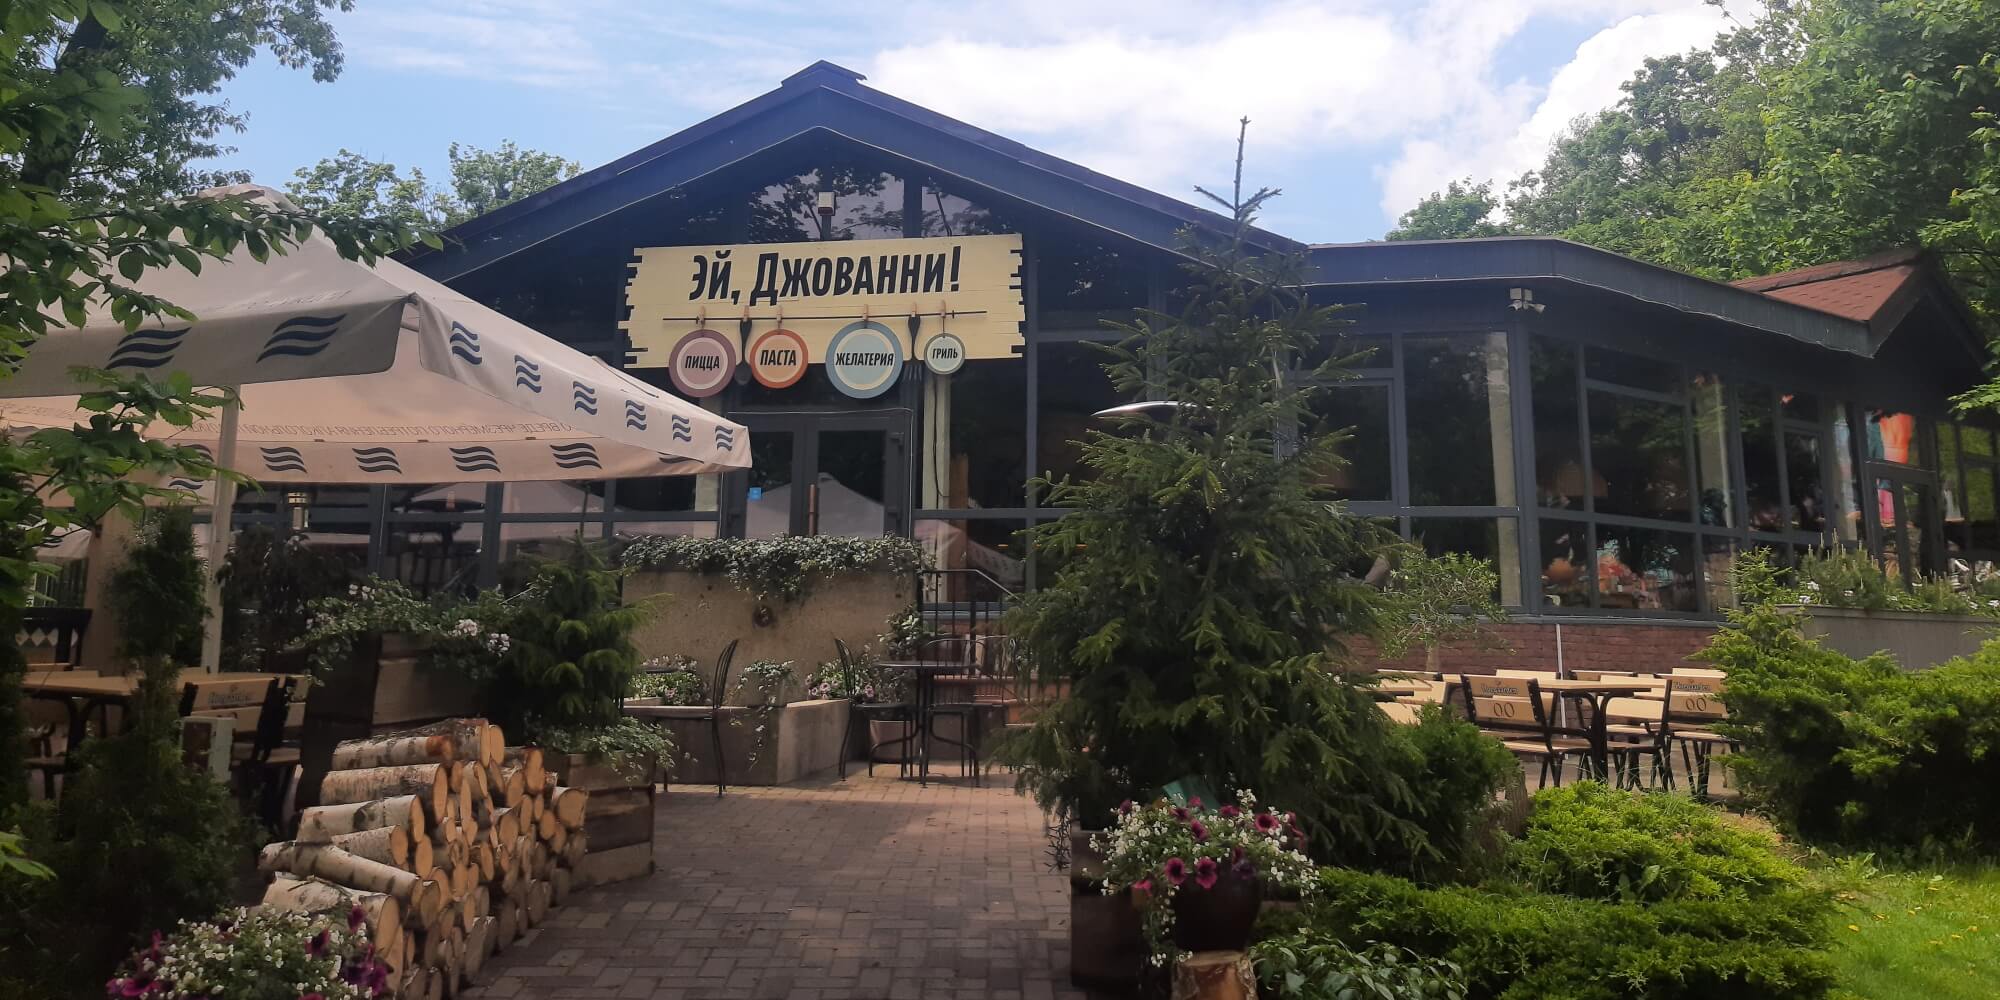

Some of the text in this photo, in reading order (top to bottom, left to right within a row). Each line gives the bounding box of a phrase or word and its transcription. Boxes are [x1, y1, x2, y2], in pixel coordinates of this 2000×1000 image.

[749, 246, 961, 306] ДЖОВАННИ!
[760, 349, 797, 366] ПАСТА
[836, 352, 894, 366] ЖЕЛАТЕРИЯ
[932, 347, 958, 359] ГРИЛЬ
[685, 355, 720, 371] ПИЦЦА
